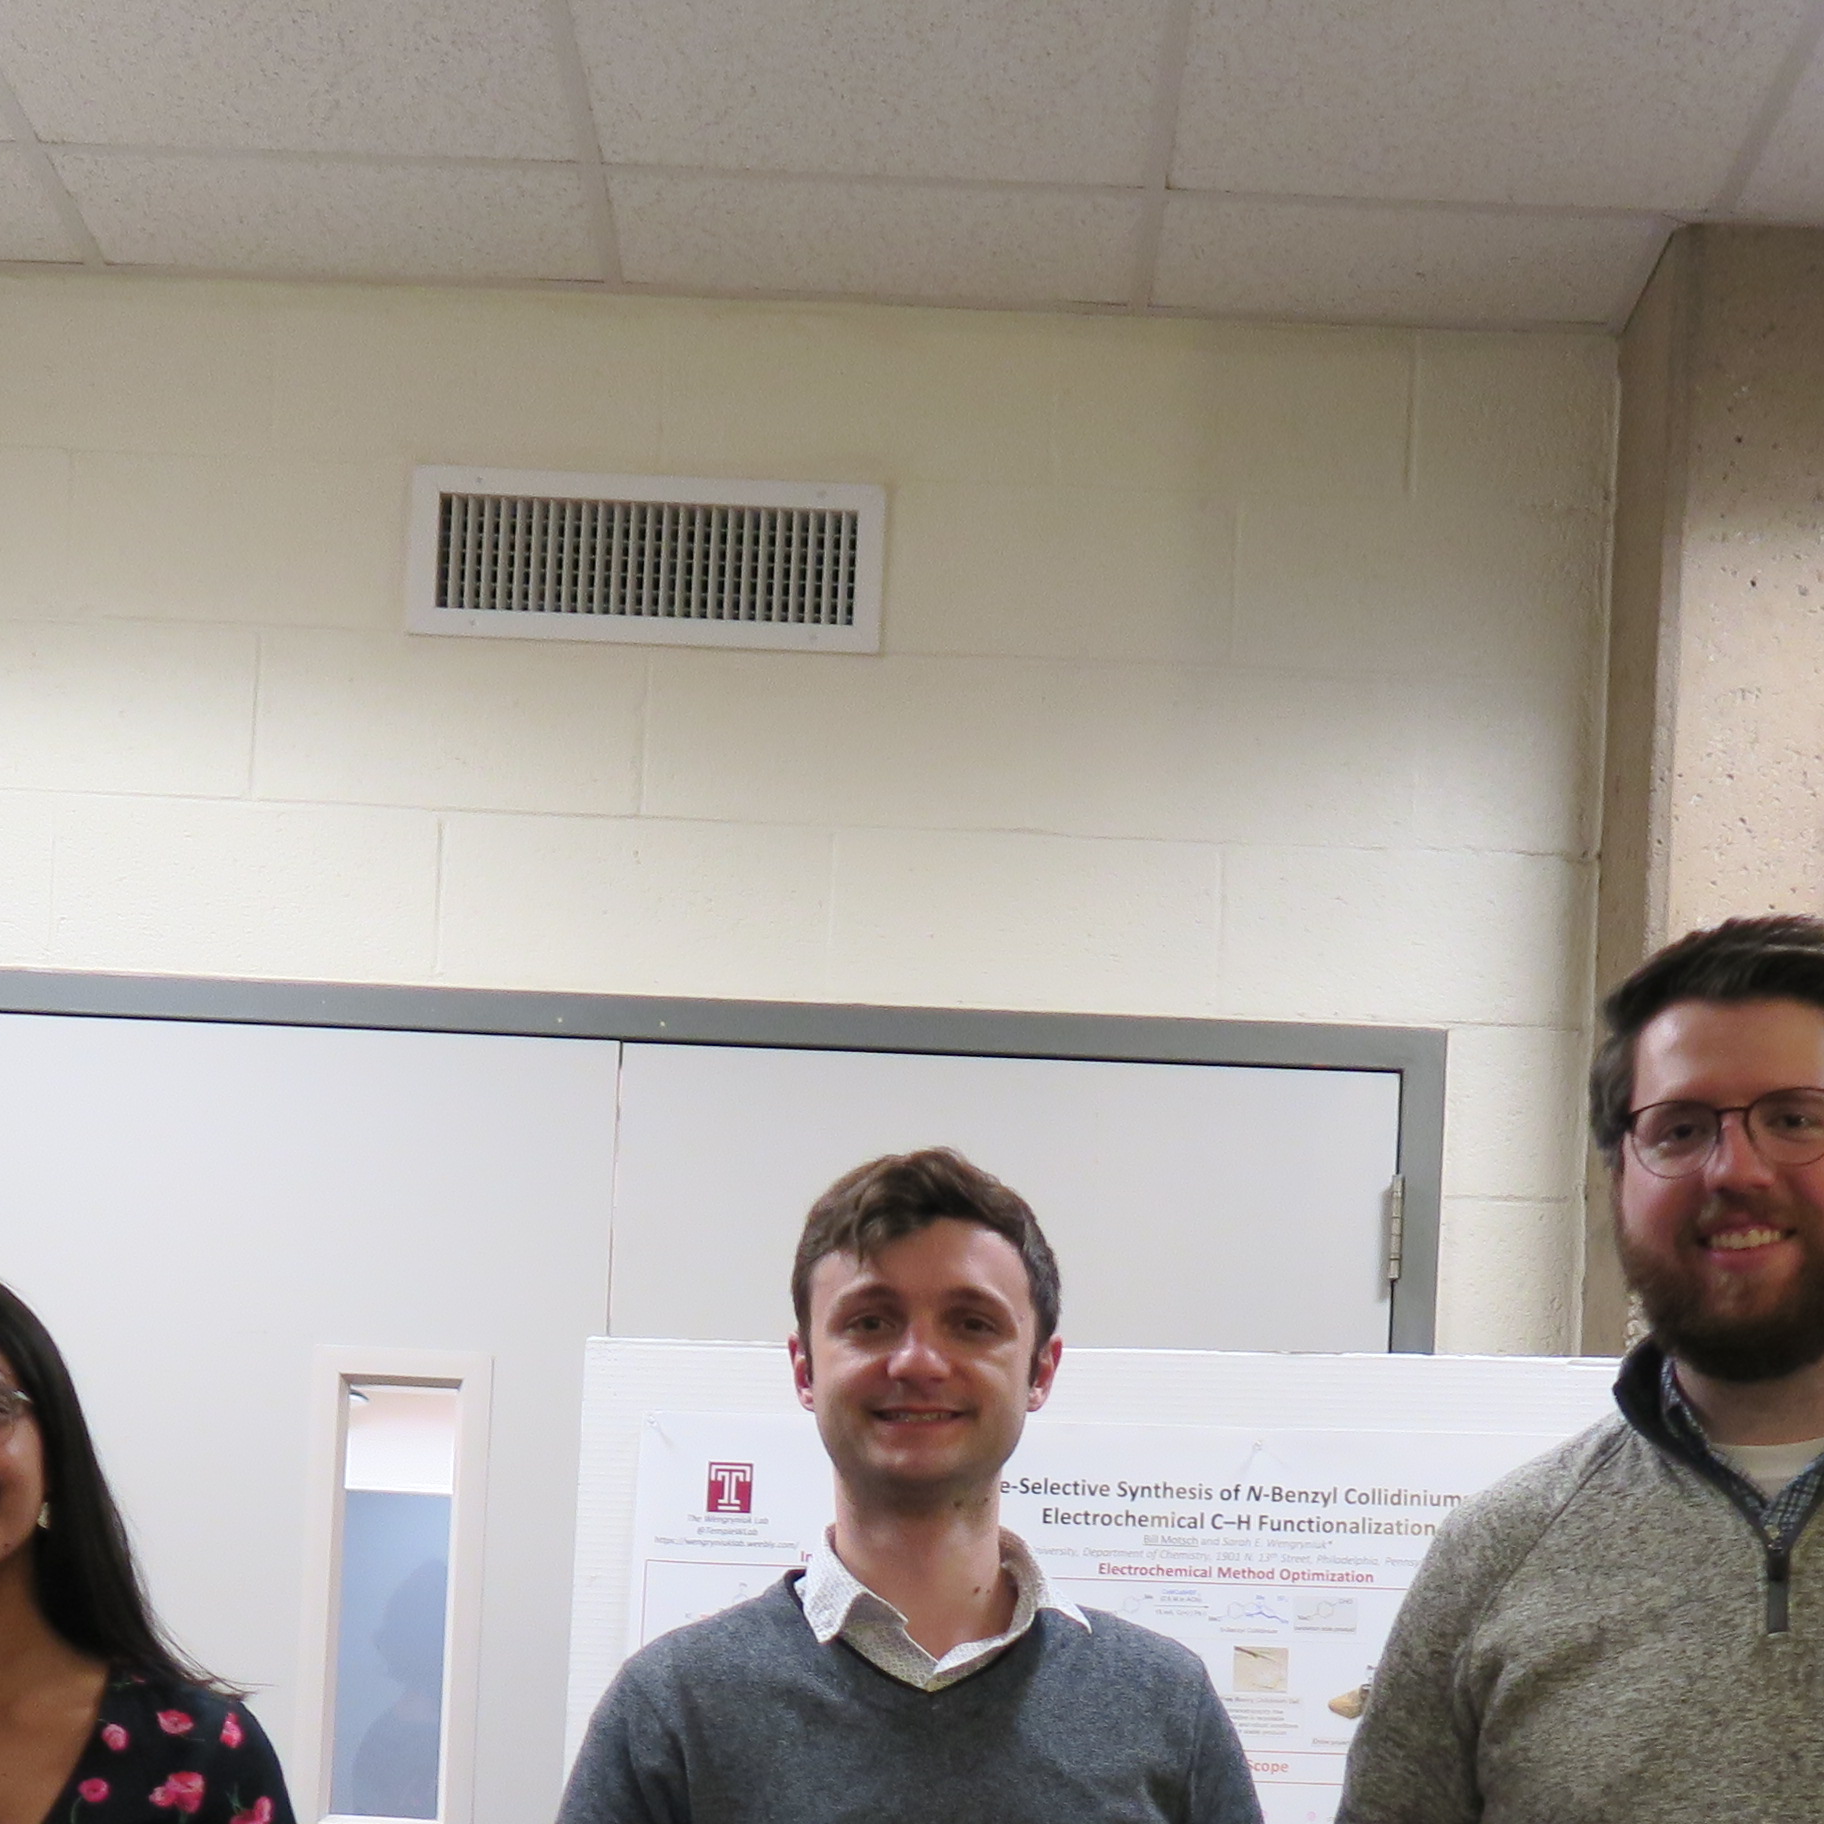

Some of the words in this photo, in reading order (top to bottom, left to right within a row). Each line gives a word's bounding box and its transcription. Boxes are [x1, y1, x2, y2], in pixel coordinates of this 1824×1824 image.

[999, 1478, 1110, 1497] e-Selective
[1116, 1481, 1213, 1502] Synthesis
[1219, 1484, 1242, 1501] of
[1246, 1485, 1337, 1508] N-Benzyl
[1344, 1488, 1467, 1508] Collidinium
[1042, 1508, 1204, 1531] Electrochemical
[1258, 1514, 1436, 1537] Functionalization
[1143, 1534, 1158, 1545] Bill
[1160, 1535, 1198, 1546] Motsch
[1200, 1537, 1219, 1547] and
[1223, 1538, 1251, 1548] Sarah
[1098, 1562, 1212, 1579] Electrochemical
[1217, 1567, 1275, 1580] Method
[1279, 1568, 1374, 1584] Optimization
